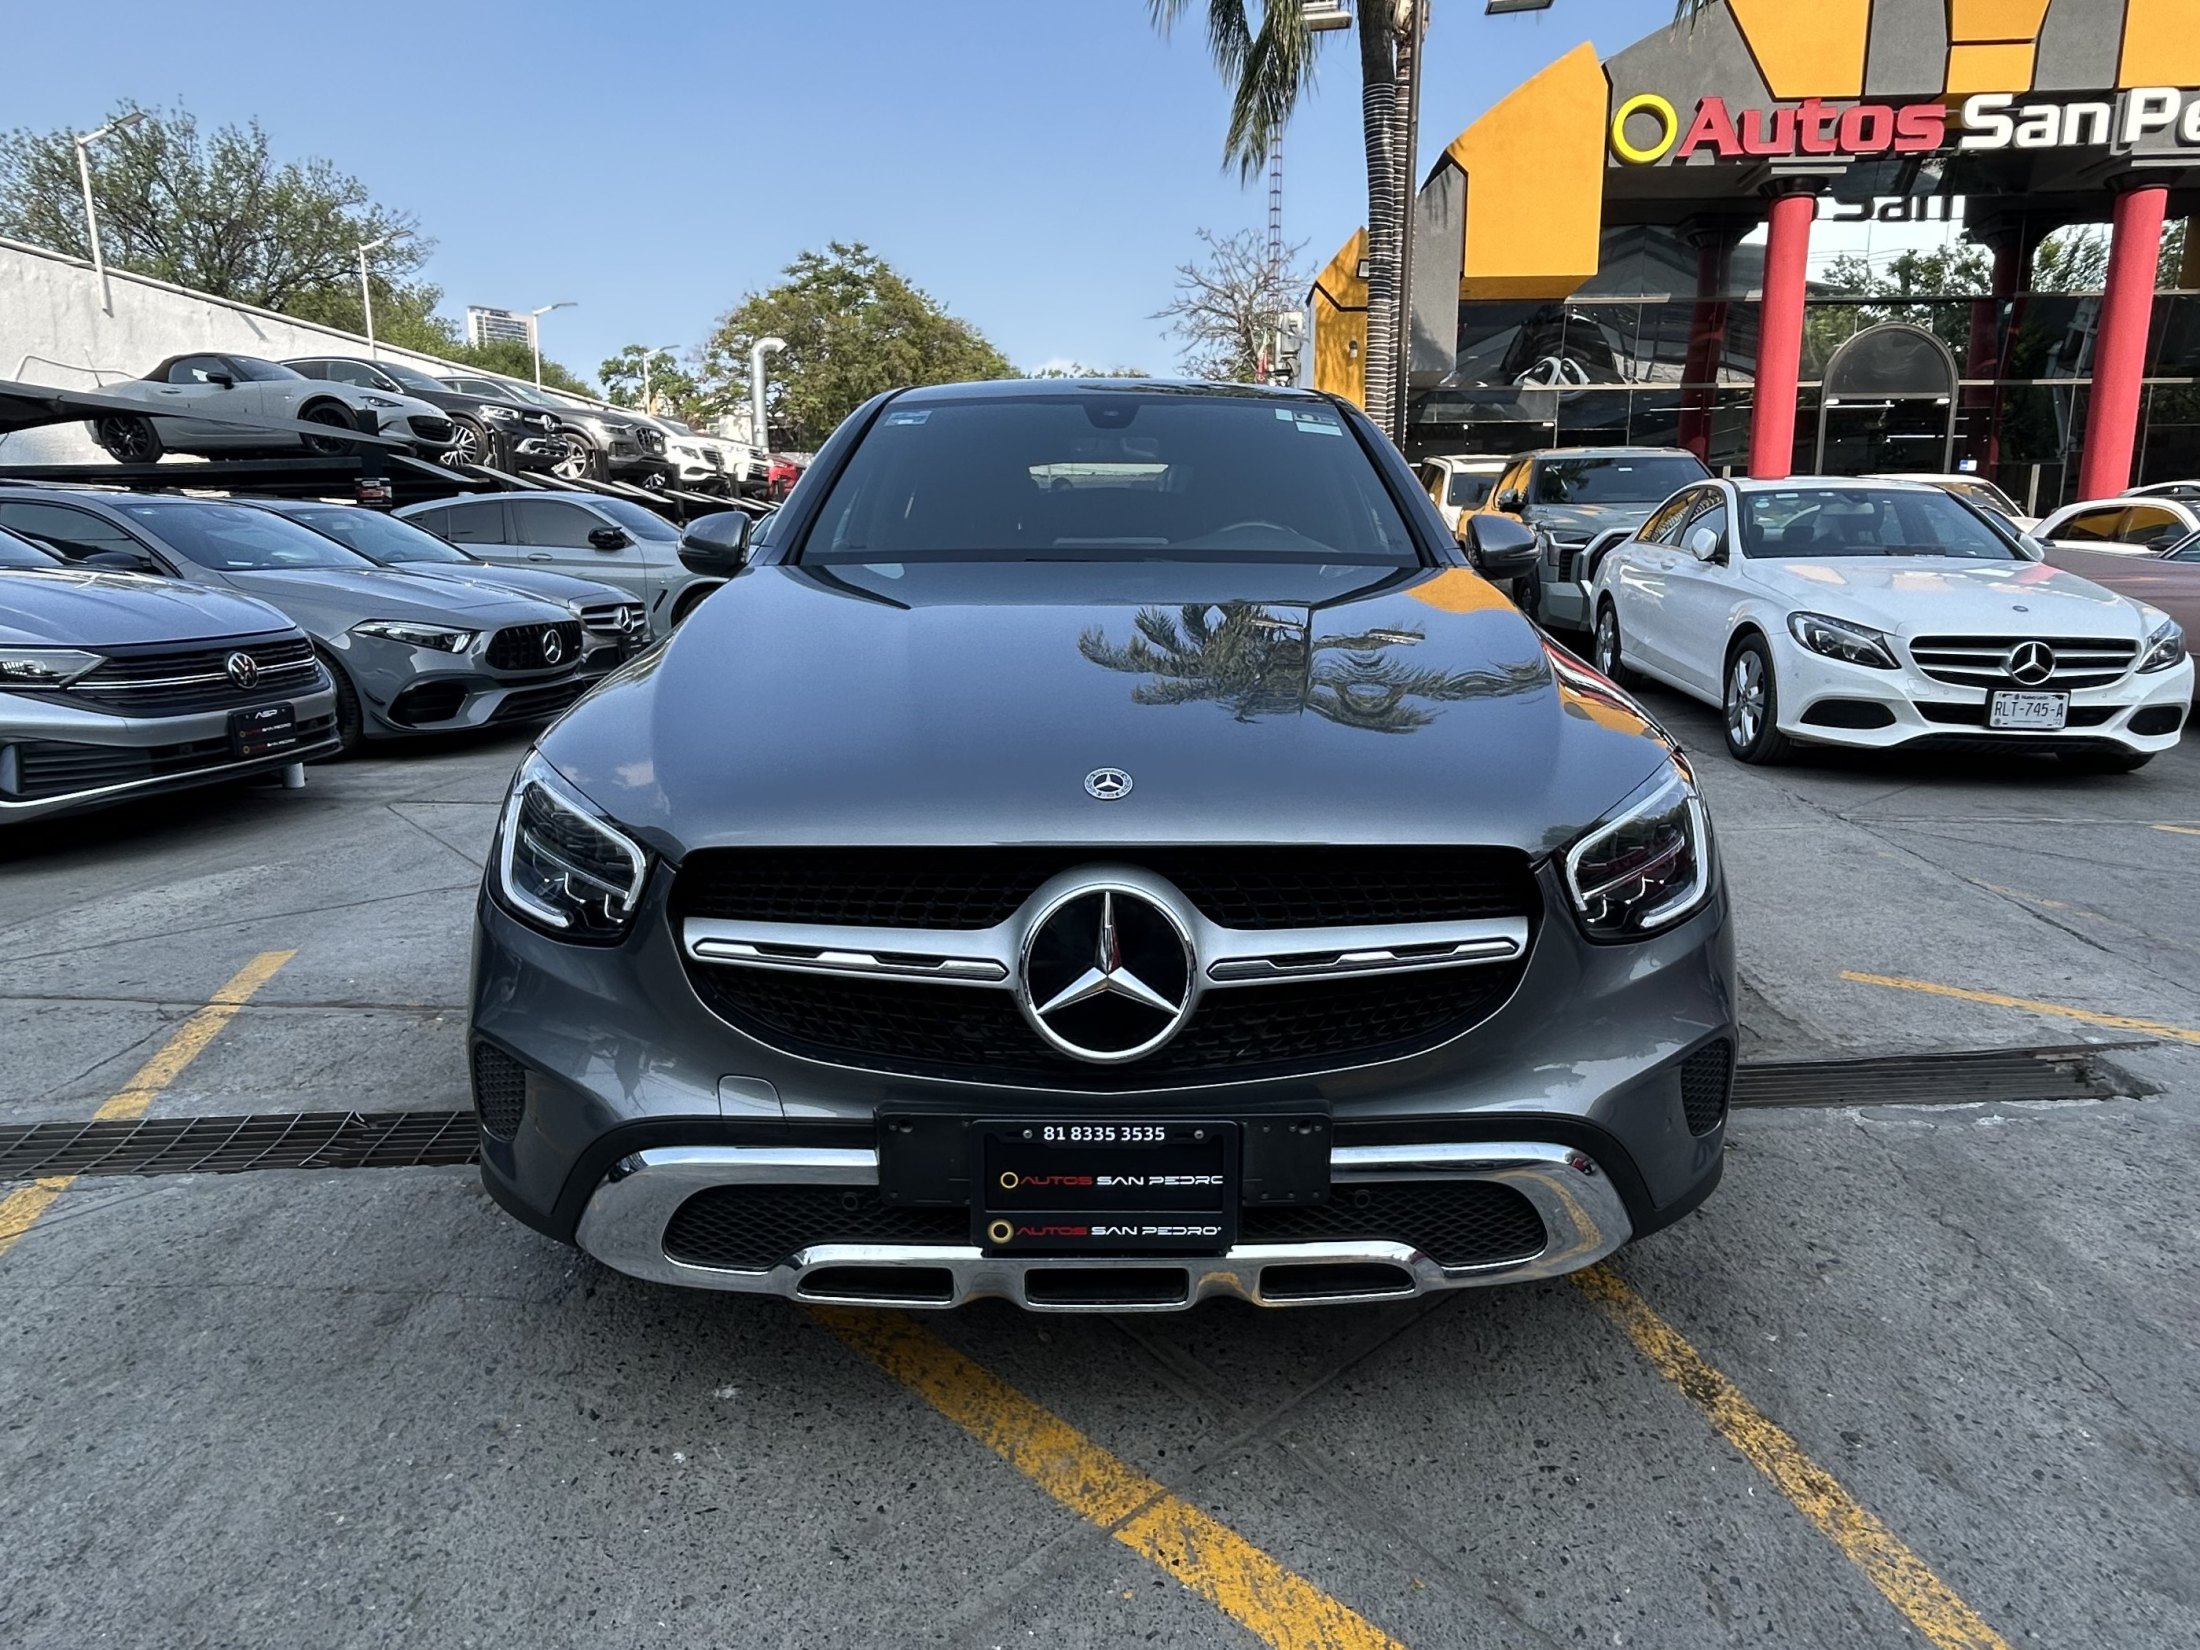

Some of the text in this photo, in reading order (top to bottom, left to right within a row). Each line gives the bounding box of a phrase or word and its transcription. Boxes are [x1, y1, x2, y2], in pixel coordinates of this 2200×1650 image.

[1678, 96, 1946, 157] Autos
[1960, 93, 2110, 150] San
[1994, 701, 2063, 718] RLT-745-A
[1043, 1127, 1166, 1141] 81 8335 3535
[1020, 1176, 1093, 1186] AUTOS
[1096, 1175, 1145, 1186] SAN
[1015, 1227, 1088, 1236] AUTOS
[1091, 1226, 1138, 1236] SAN
